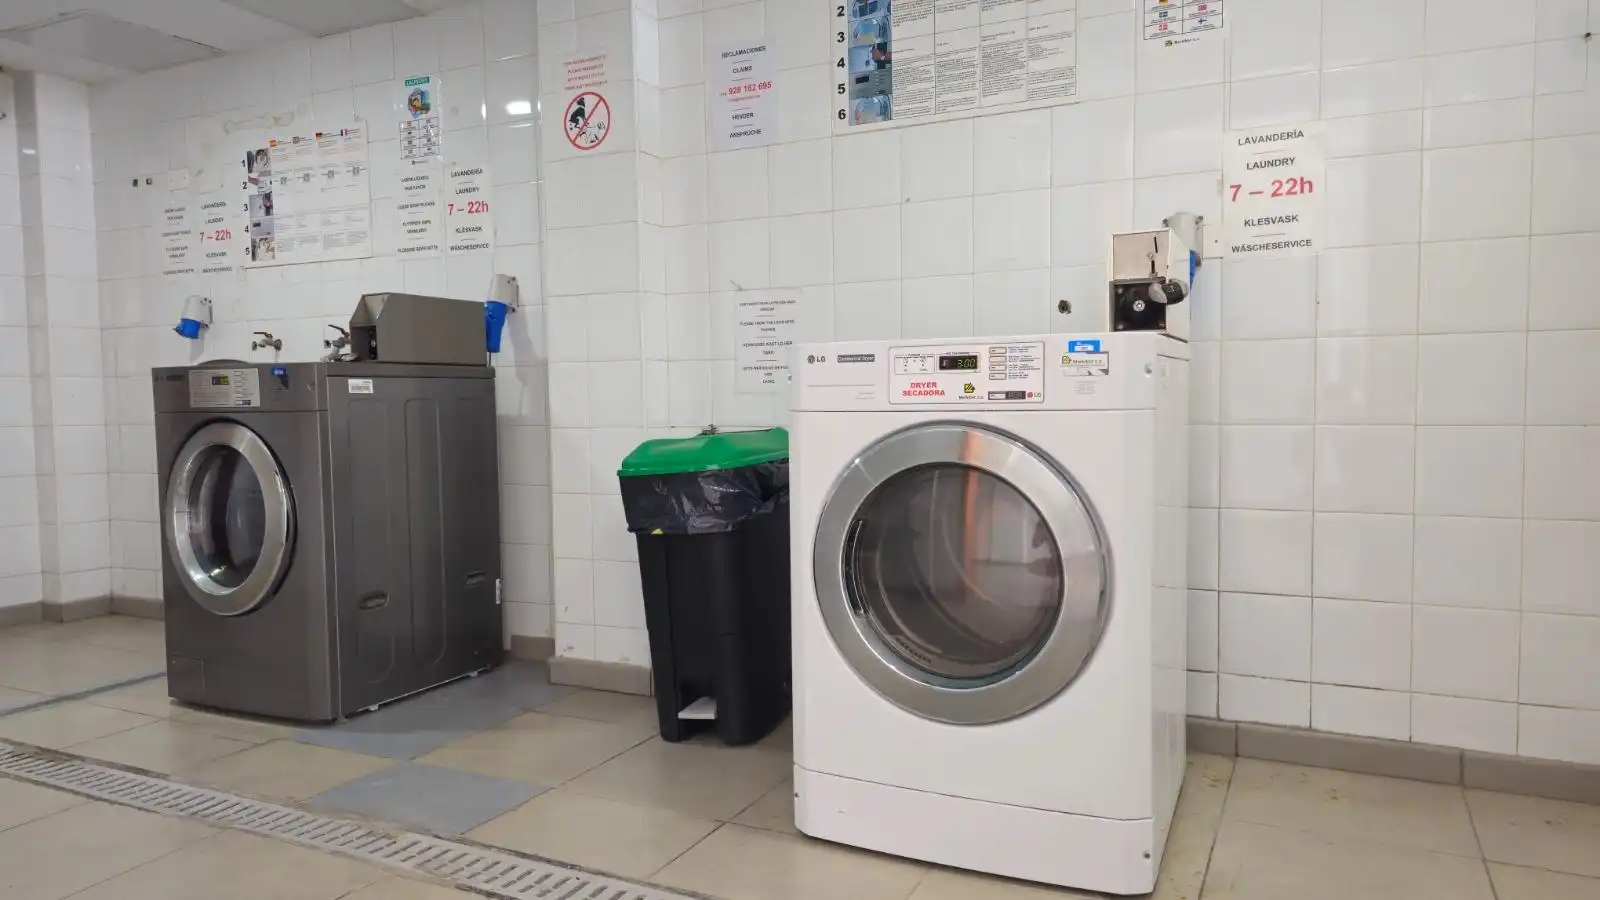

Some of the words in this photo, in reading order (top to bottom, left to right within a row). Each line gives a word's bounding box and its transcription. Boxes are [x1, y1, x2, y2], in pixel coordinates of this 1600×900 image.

[837, 5, 845, 17] 2
[837, 31, 845, 43] 3
[837, 57, 845, 68] 4
[732, 65, 753, 74] CLAIMS
[728, 86, 741, 95] 928
[758, 81, 772, 91] 695
[837, 83, 846, 94] 5
[838, 109, 846, 120] 6
[1238, 129, 1305, 146] LAVANDERÍA
[241, 159, 246, 167] 1
[1246, 157, 1296, 171] LAUNDRY
[242, 181, 247, 189] 2
[1229, 183, 1242, 202] 7
[1271, 176, 1314, 198] 22h
[455, 187, 480, 195] LAUNDRY
[243, 203, 248, 211] 3
[448, 203, 454, 216] 7
[467, 201, 489, 214] 22h
[1244, 214, 1299, 228] KLESVASK
[244, 225, 249, 233] 4
[199, 231, 204, 244] 7
[215, 228, 231, 241] 22h
[245, 247, 250, 255] 5
[1231, 239, 1312, 253] WÄSCHESERVICE
